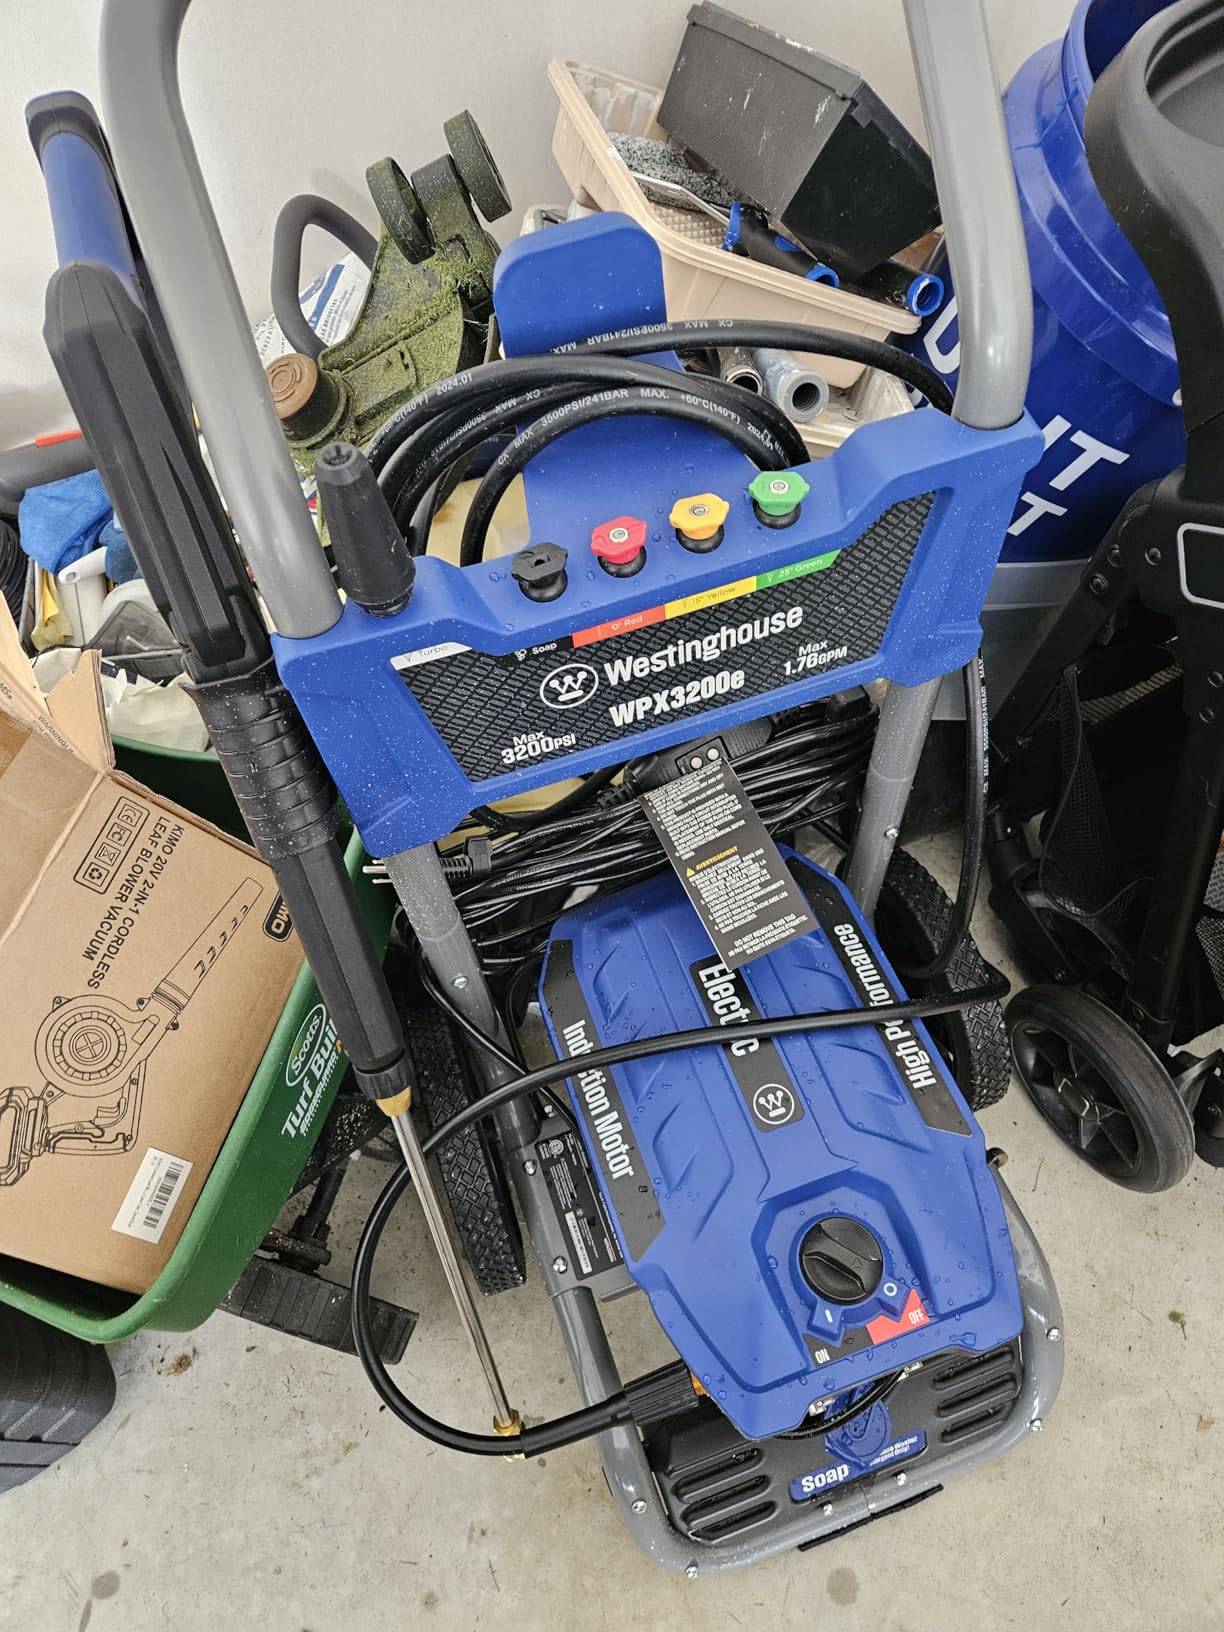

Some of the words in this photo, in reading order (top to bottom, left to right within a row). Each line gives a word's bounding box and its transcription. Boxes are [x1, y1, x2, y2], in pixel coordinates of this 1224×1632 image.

[718, 319, 734, 328] CX
[436, 372, 473, 396] 2024.01
[526, 389, 541, 401] CX
[541, 388, 629, 427] 3500PSI/241BAR
[640, 388, 670, 399] MAX.
[794, 558, 823, 574] Green
[706, 586, 736, 601] Yellow
[624, 615, 643, 627] Red
[417, 644, 449, 658] Turbo
[531, 642, 558, 655] Soap
[603, 606, 803, 686] Westinghouse
[798, 639, 828, 657] Max
[608, 670, 746, 727] WPX3200e
[38, 715, 68, 748] WARNING!
[513, 730, 545, 746] Max
[148, 815, 170, 848] LEAF
[162, 824, 184, 855] KIMO
[150, 855, 168, 880] 20V
[695, 844, 738, 871] AVERTISSEMENT
[114, 847, 152, 903] BLOWER
[129, 879, 155, 915] 2-IN-1
[82, 905, 123, 961] VACUUM
[741, 932, 754, 944] NOT
[752, 922, 775, 938] REMOVE
[772, 917, 785, 928] THIS
[87, 916, 135, 989] CORDLESS
[834, 923, 911, 1041] Pformance
[698, 962, 760, 1057] Electc
[895, 1044, 937, 1089] High
[281, 1078, 315, 1139] Turf
[563, 1020, 610, 1117] Indtion
[593, 1110, 635, 1179] Motor
[908, 1308, 924, 1325] OFF
[814, 1348, 829, 1365] ON
[801, 1463, 850, 1493] Soap
